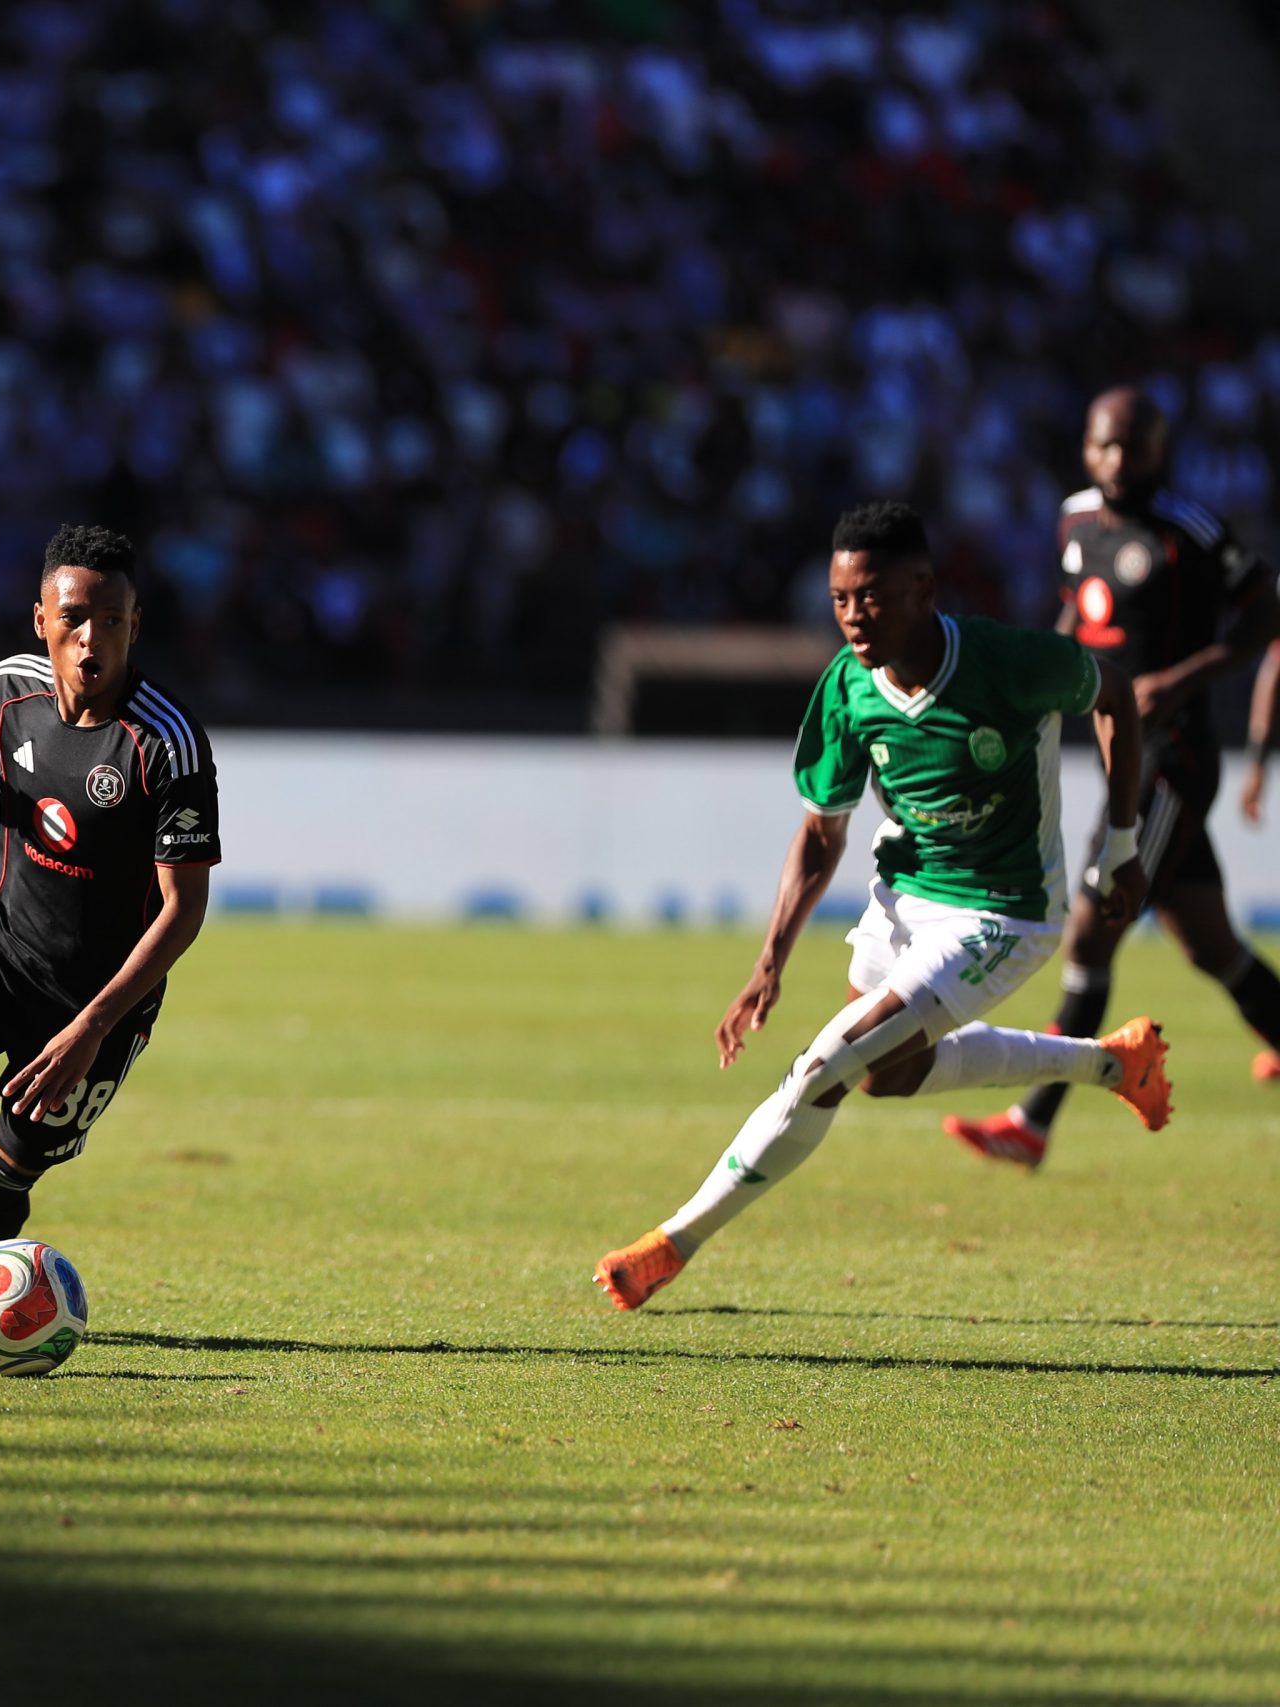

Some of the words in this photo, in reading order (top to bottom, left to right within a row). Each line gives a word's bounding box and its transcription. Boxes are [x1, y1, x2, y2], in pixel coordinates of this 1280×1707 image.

[162, 833, 211, 845] SUZUK
[24, 842, 95, 880] vodacom
[42, 1078, 116, 1131] 38
